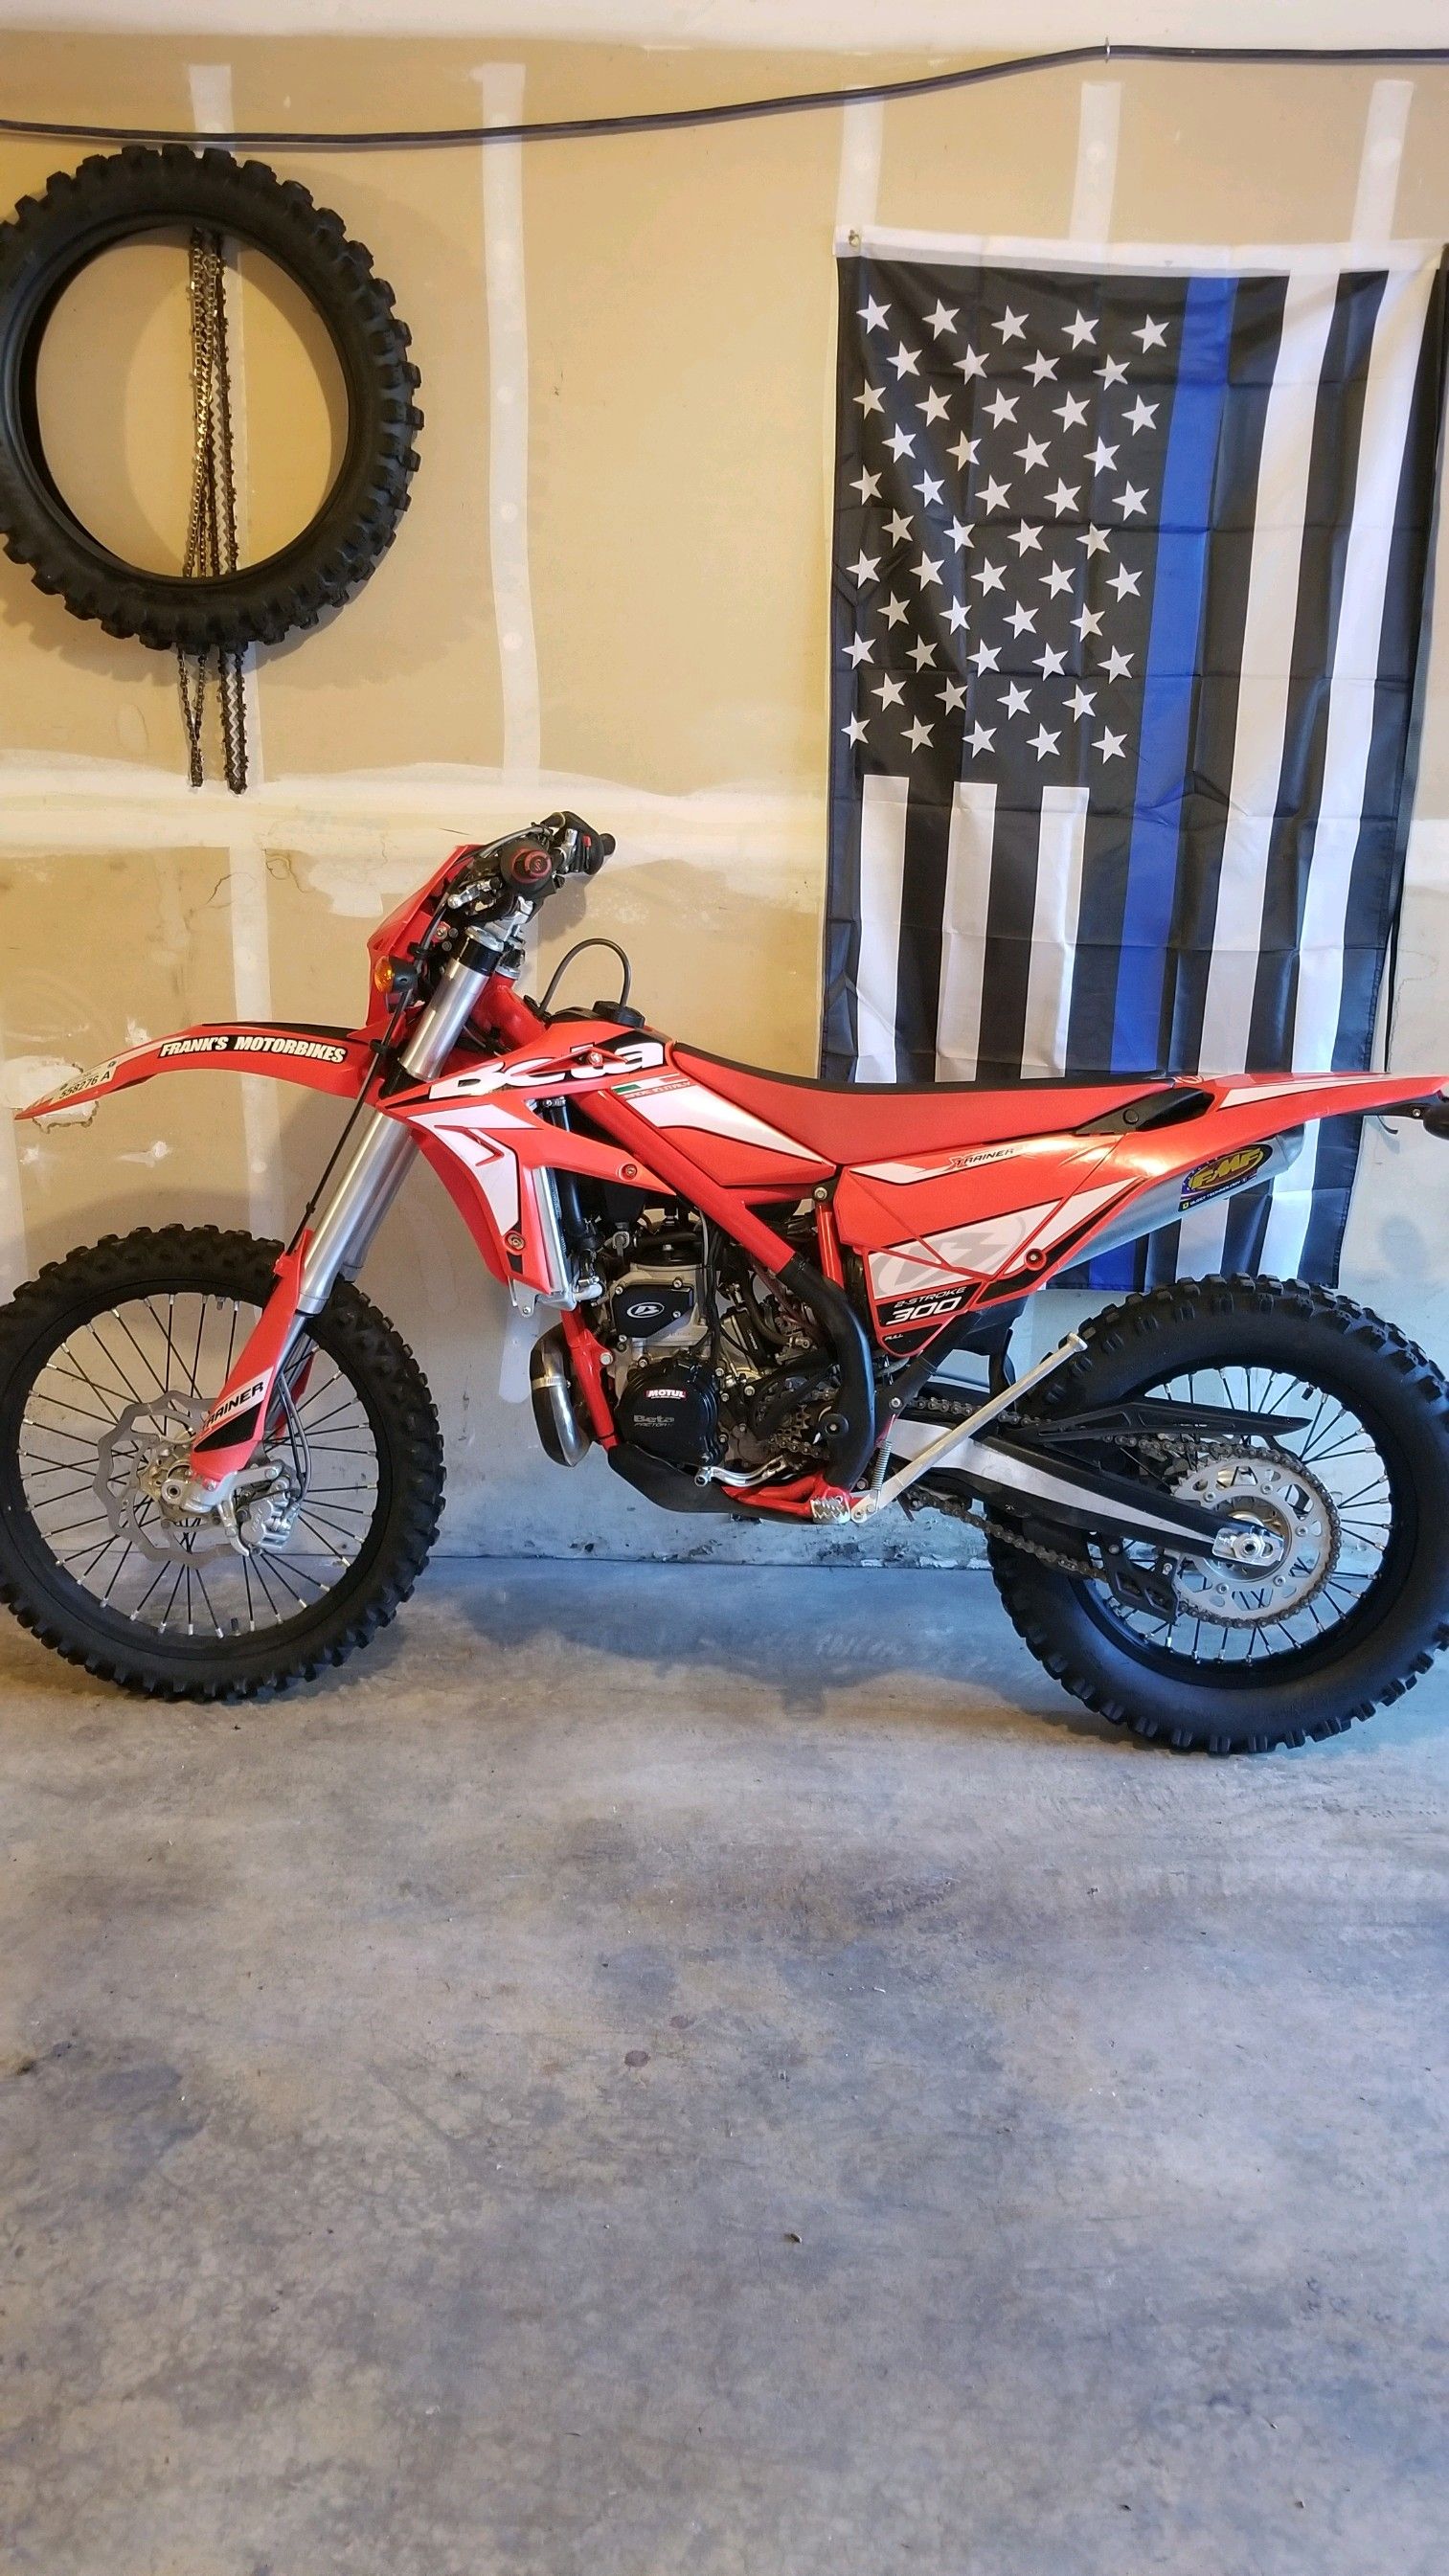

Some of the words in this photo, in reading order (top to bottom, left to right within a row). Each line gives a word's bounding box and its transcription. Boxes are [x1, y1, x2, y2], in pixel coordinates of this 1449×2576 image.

[160, 1036, 228, 1057] FRANK'S
[234, 1036, 346, 1063] MOTORBIKES
[58, 1075, 99, 1099] 558276
[101, 1071, 110, 1082] A
[1190, 1148, 1261, 1189] FMF
[894, 1286, 966, 1308] 2-STROKE
[886, 1297, 962, 1325] 300
[647, 1389, 686, 1398] MOTUL
